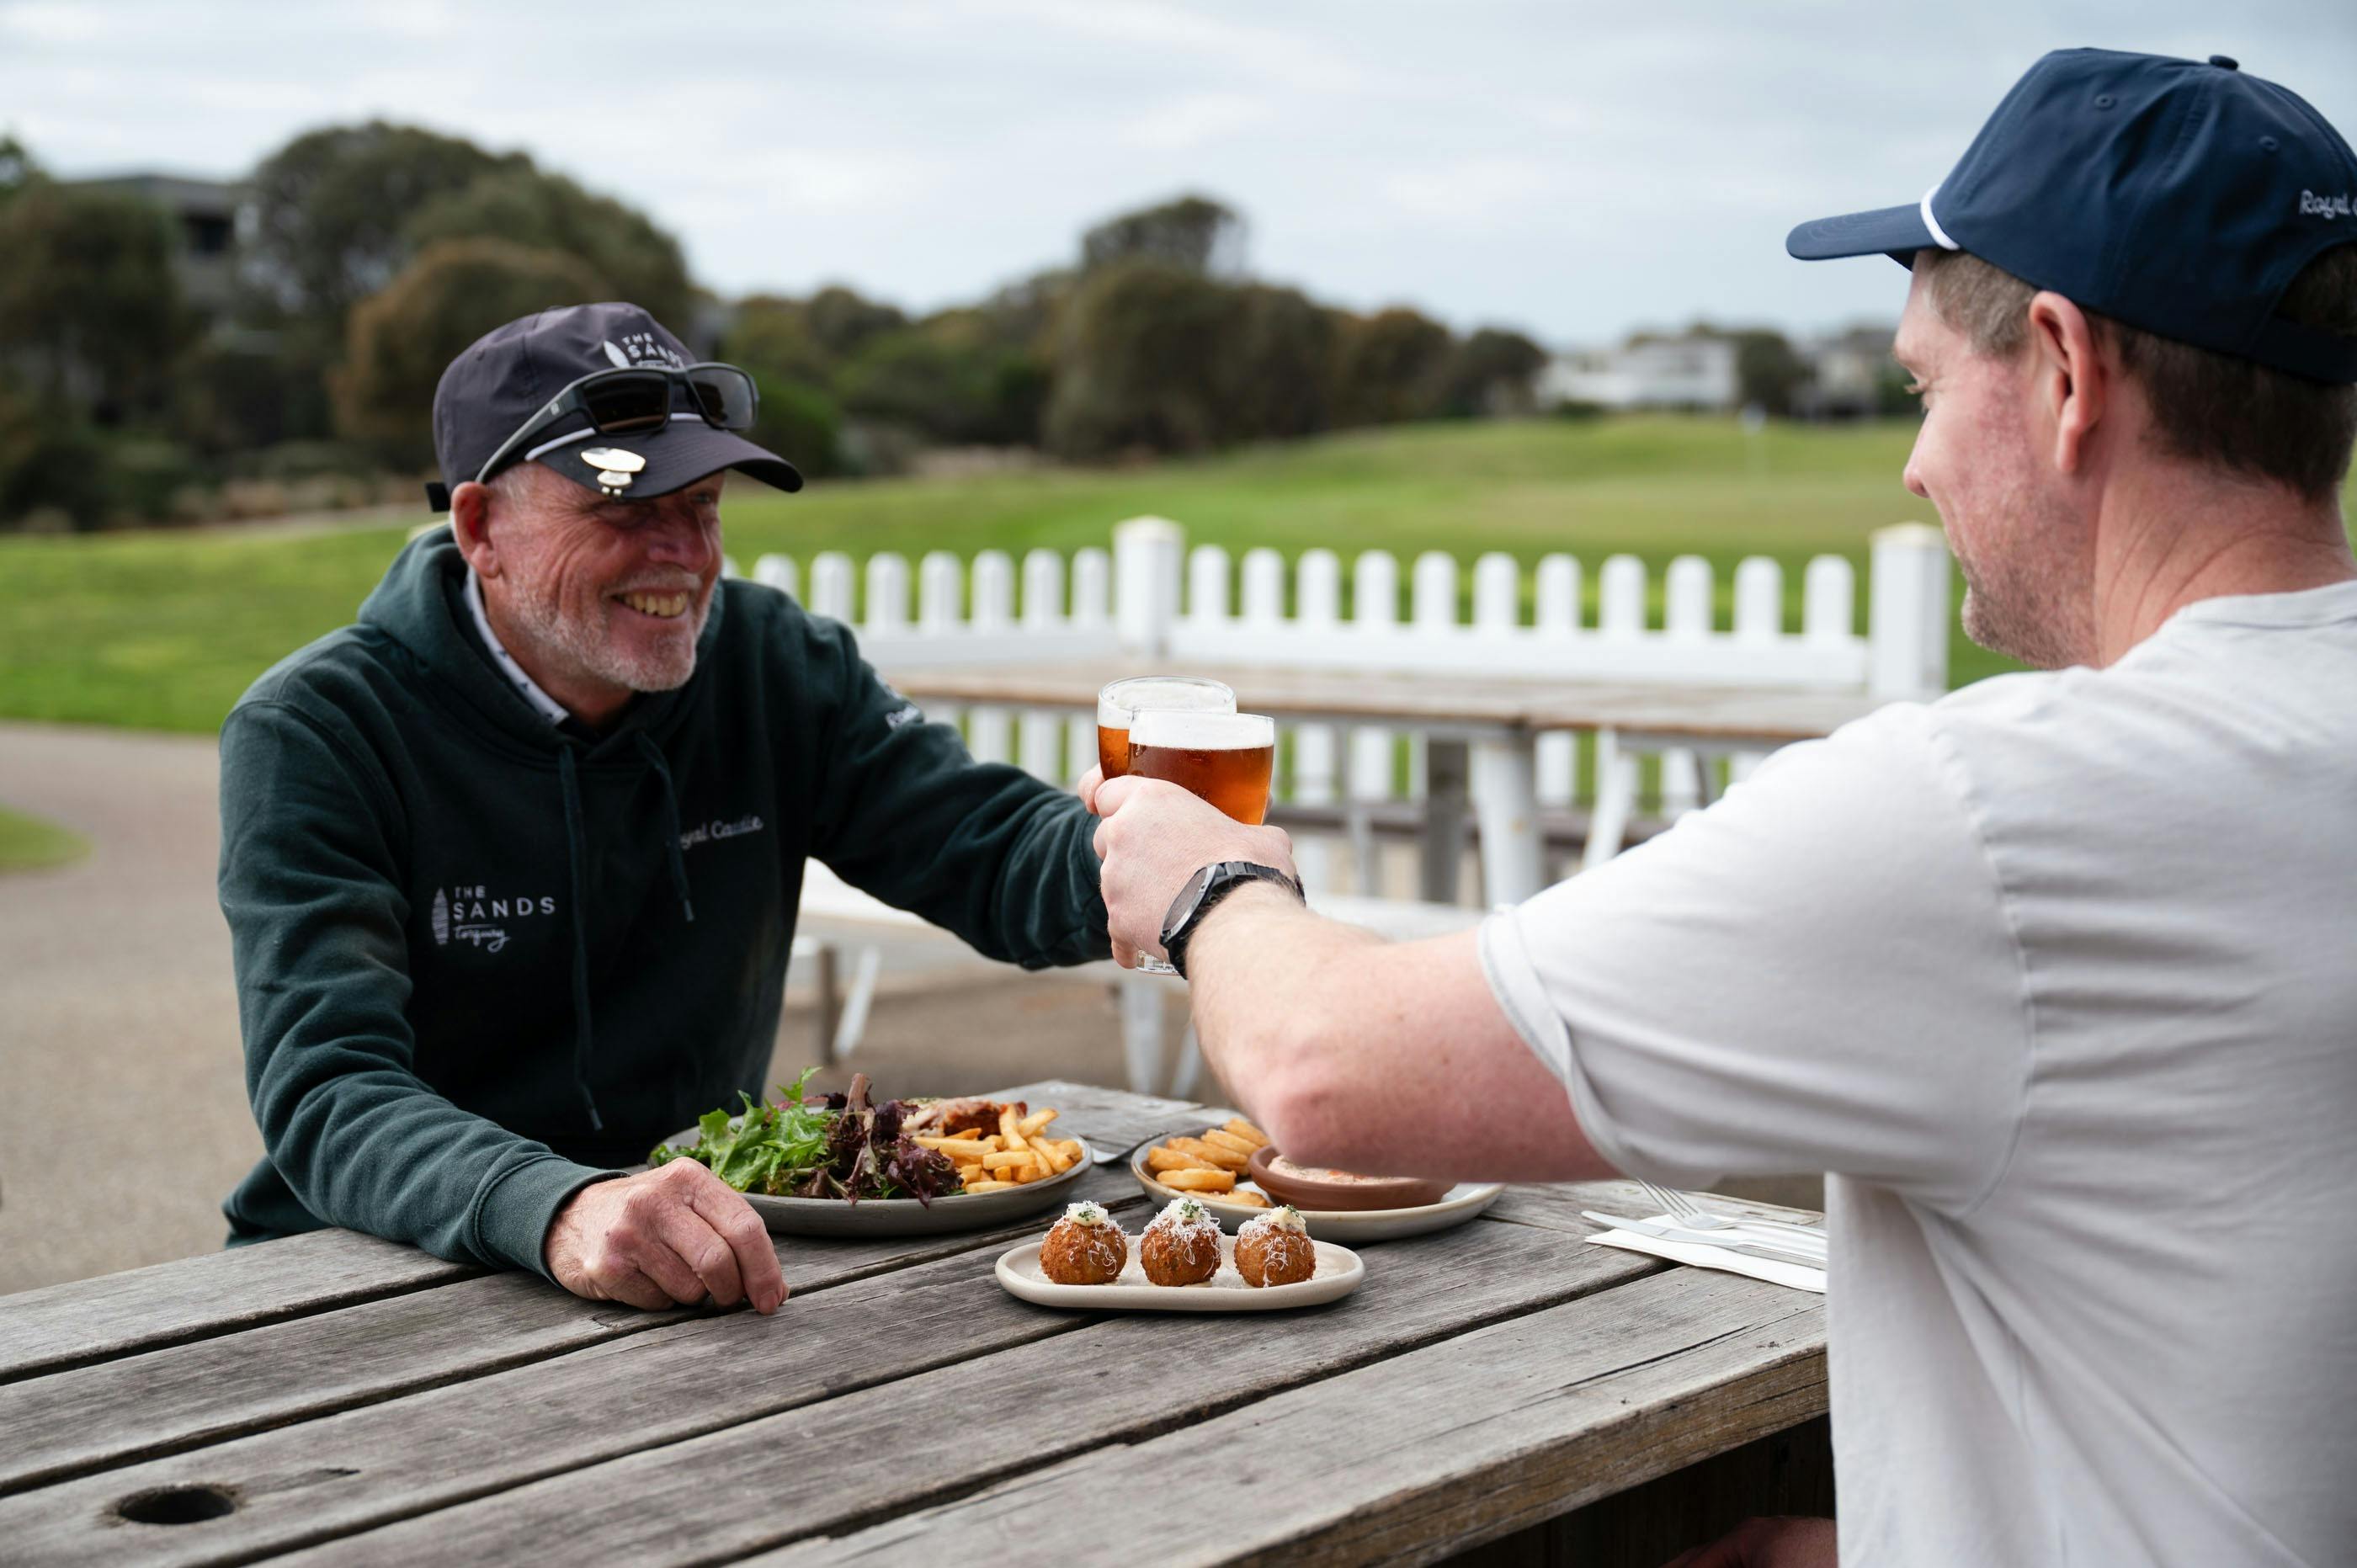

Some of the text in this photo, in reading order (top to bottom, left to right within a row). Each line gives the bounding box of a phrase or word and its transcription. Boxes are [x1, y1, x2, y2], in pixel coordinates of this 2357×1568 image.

[2299, 189, 2351, 219] Royal
[622, 332, 653, 345] THE
[455, 885, 486, 899] THE
[453, 896, 556, 921] SANDS
